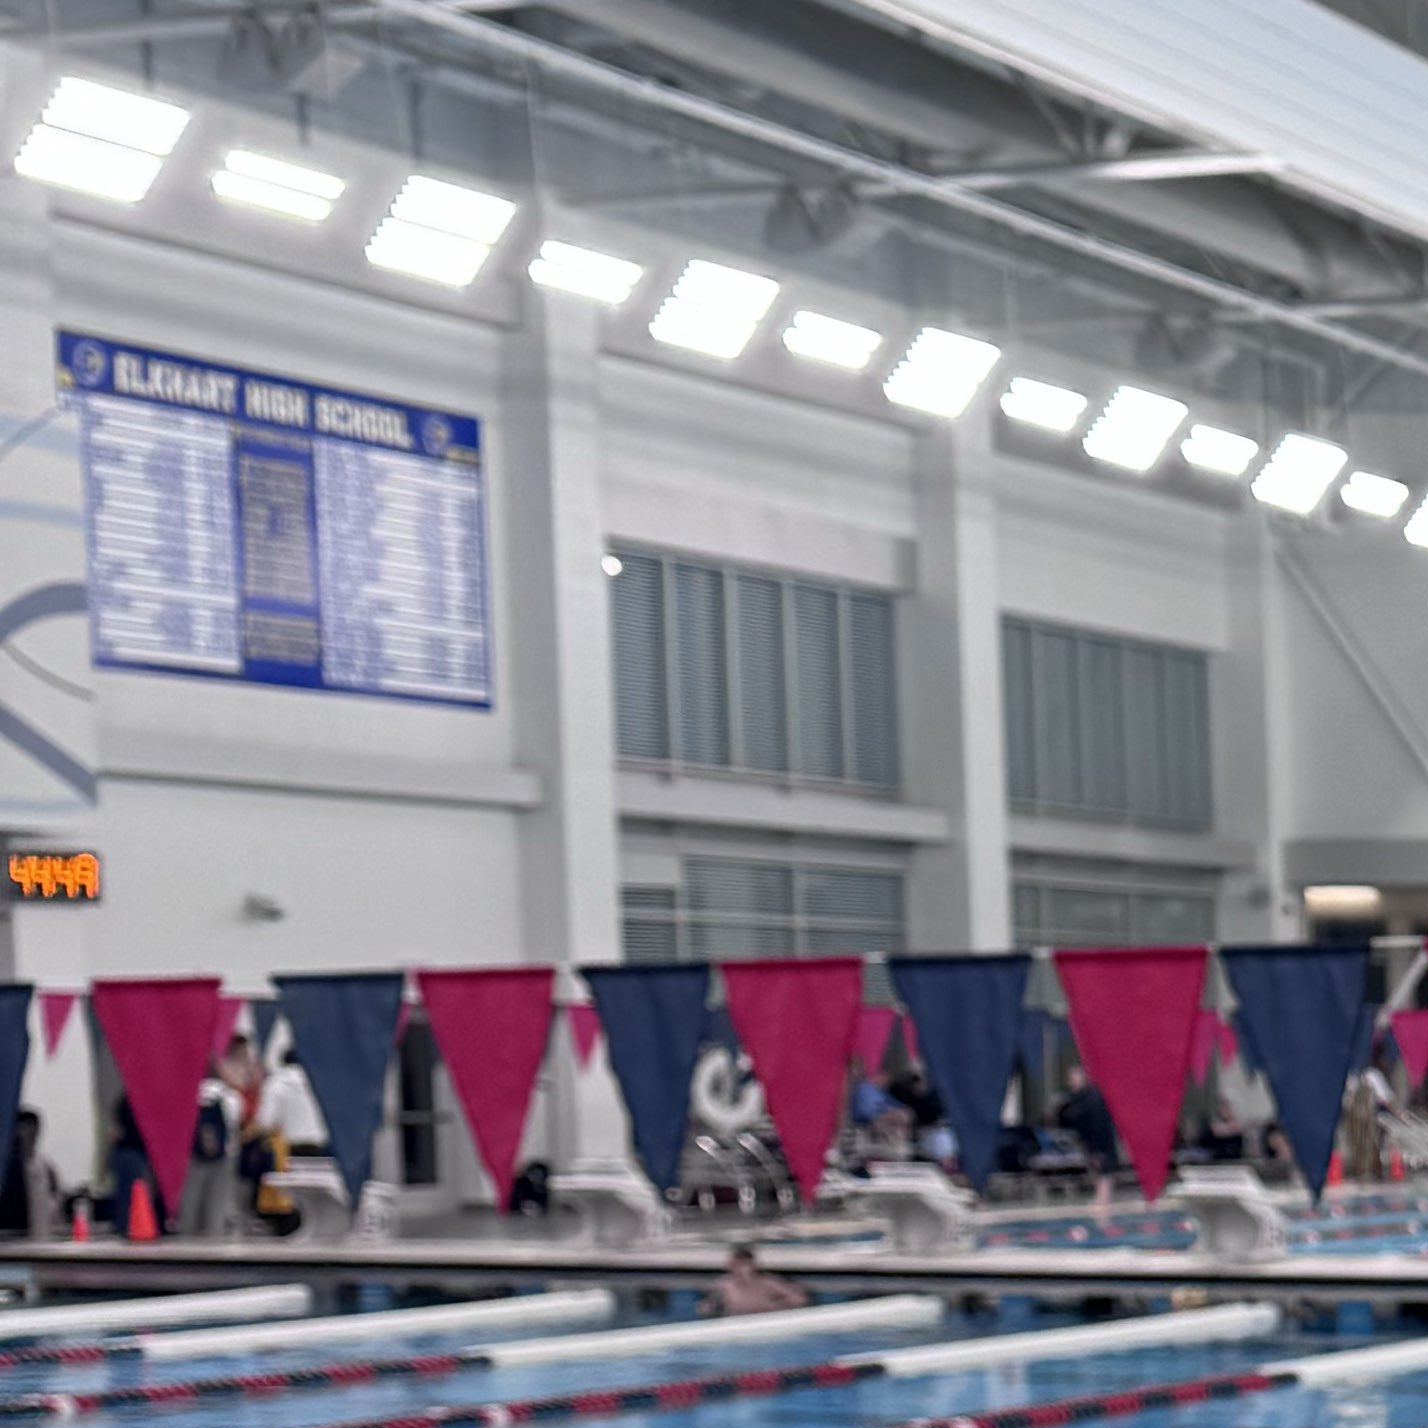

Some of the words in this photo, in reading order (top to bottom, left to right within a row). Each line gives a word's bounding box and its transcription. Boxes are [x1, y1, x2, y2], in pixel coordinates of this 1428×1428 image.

[113, 352, 238, 415] ELKHART
[245, 379, 309, 428] HIGH
[314, 395, 414, 449] SCHOOL
